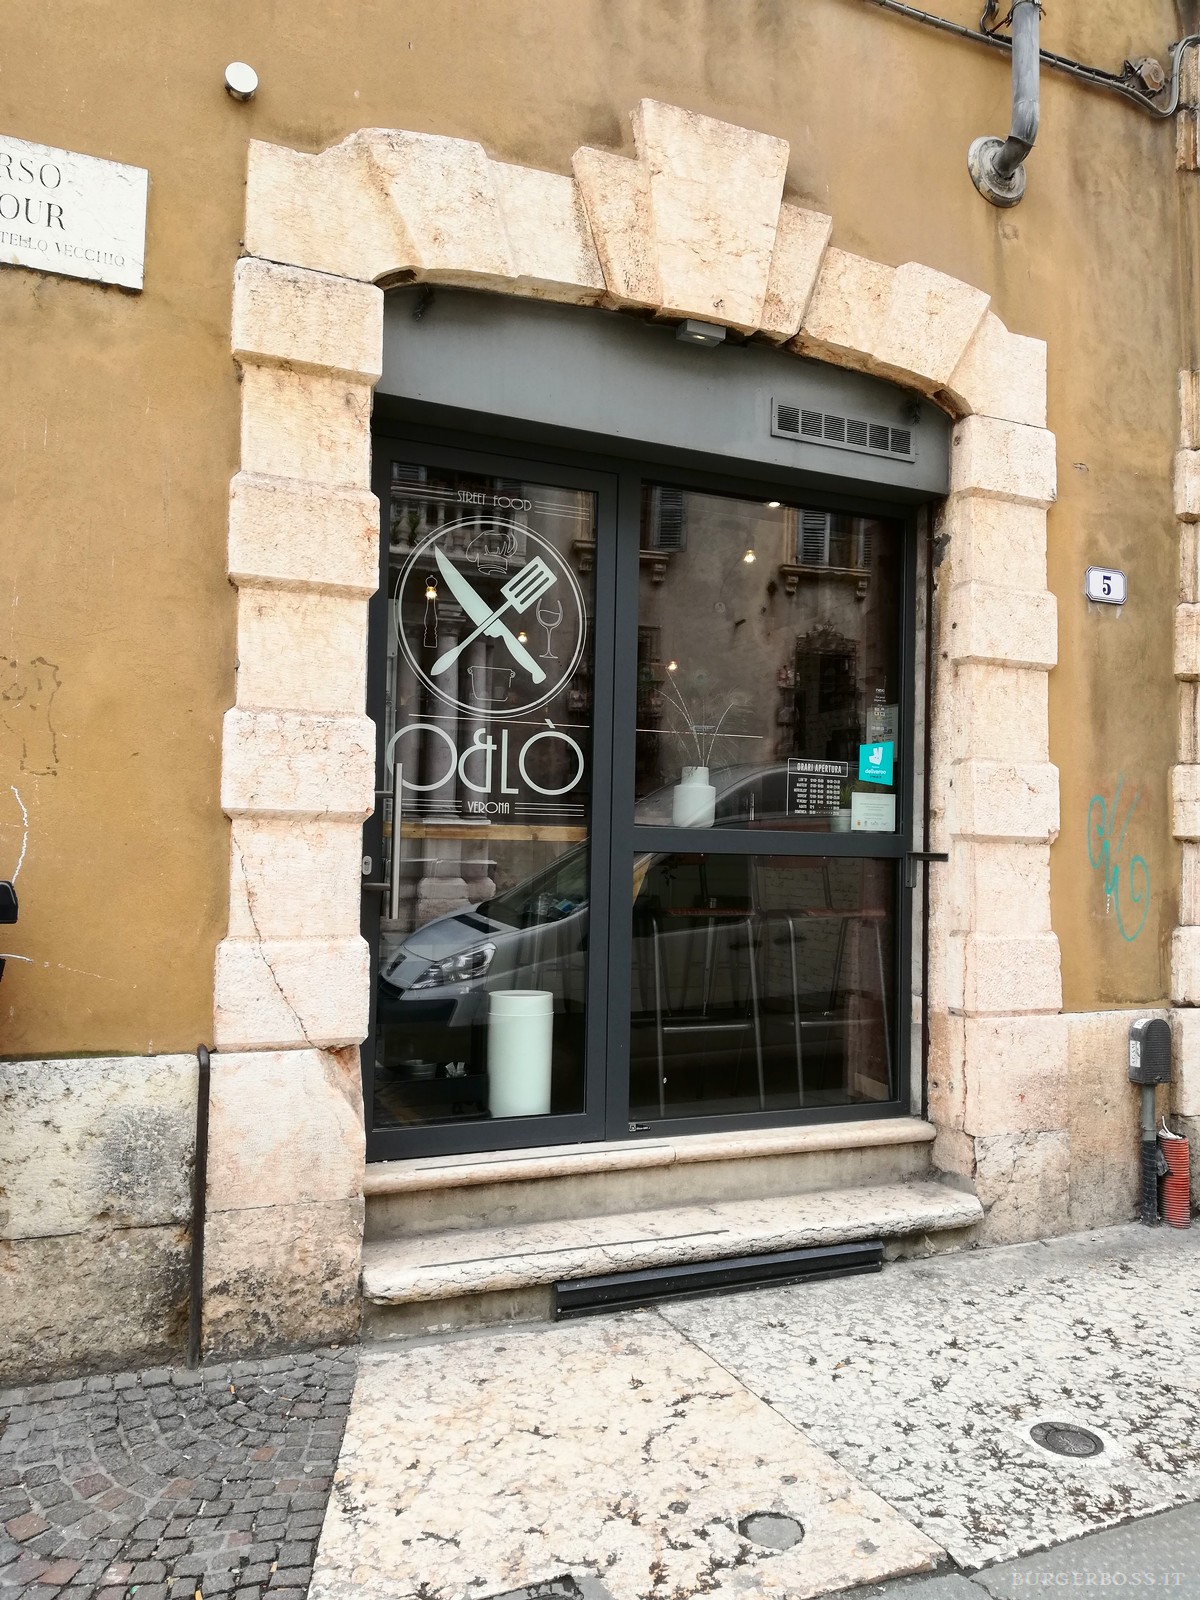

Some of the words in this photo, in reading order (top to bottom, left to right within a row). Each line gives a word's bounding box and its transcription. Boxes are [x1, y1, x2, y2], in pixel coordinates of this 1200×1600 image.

[0, 193, 66, 231] OUR
[55, 242, 125, 267] VECCHIO
[457, 490, 486, 505] STREET
[493, 495, 532, 511] FOOD
[1102, 575, 1112, 596] 5
[796, 762, 814, 772] ORARI
[814, 764, 842, 774] APERTURA
[467, 801, 510, 815] VERONA
